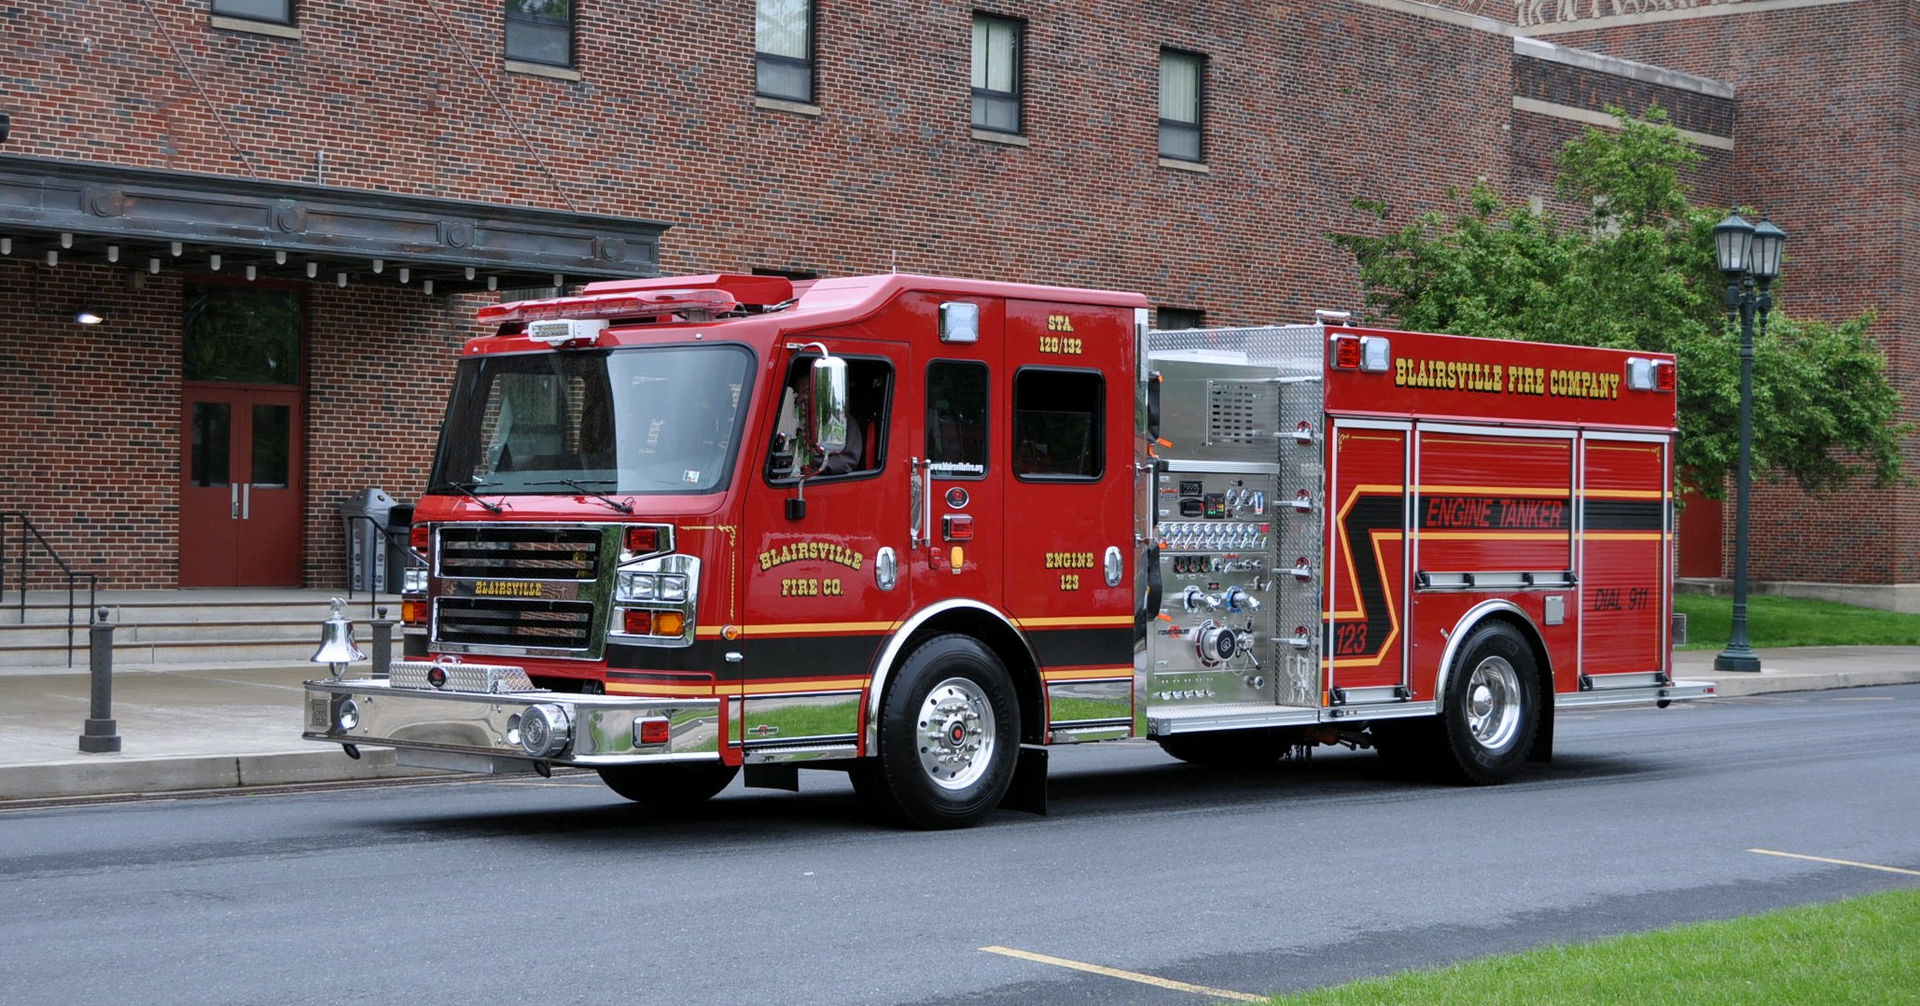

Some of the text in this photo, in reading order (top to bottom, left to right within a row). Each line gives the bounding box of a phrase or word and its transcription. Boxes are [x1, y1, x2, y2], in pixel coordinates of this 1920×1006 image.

[1048, 315, 1074, 332] STA.
[1039, 336, 1082, 355] 120/132
[1395, 358, 1619, 399] BLAIRSVILLE FIRE COMPANY
[1426, 498, 1563, 528] ENGINE TANKER
[760, 542, 863, 571] BLAIRSVILLE
[1045, 552, 1094, 569] ENGINE
[475, 580, 542, 597] BLAIRSVILLE
[782, 578, 844, 596] FIRE CO.
[1060, 574, 1079, 591] 123
[1594, 587, 1648, 611] DIAL 911
[1337, 623, 1368, 655] 123
